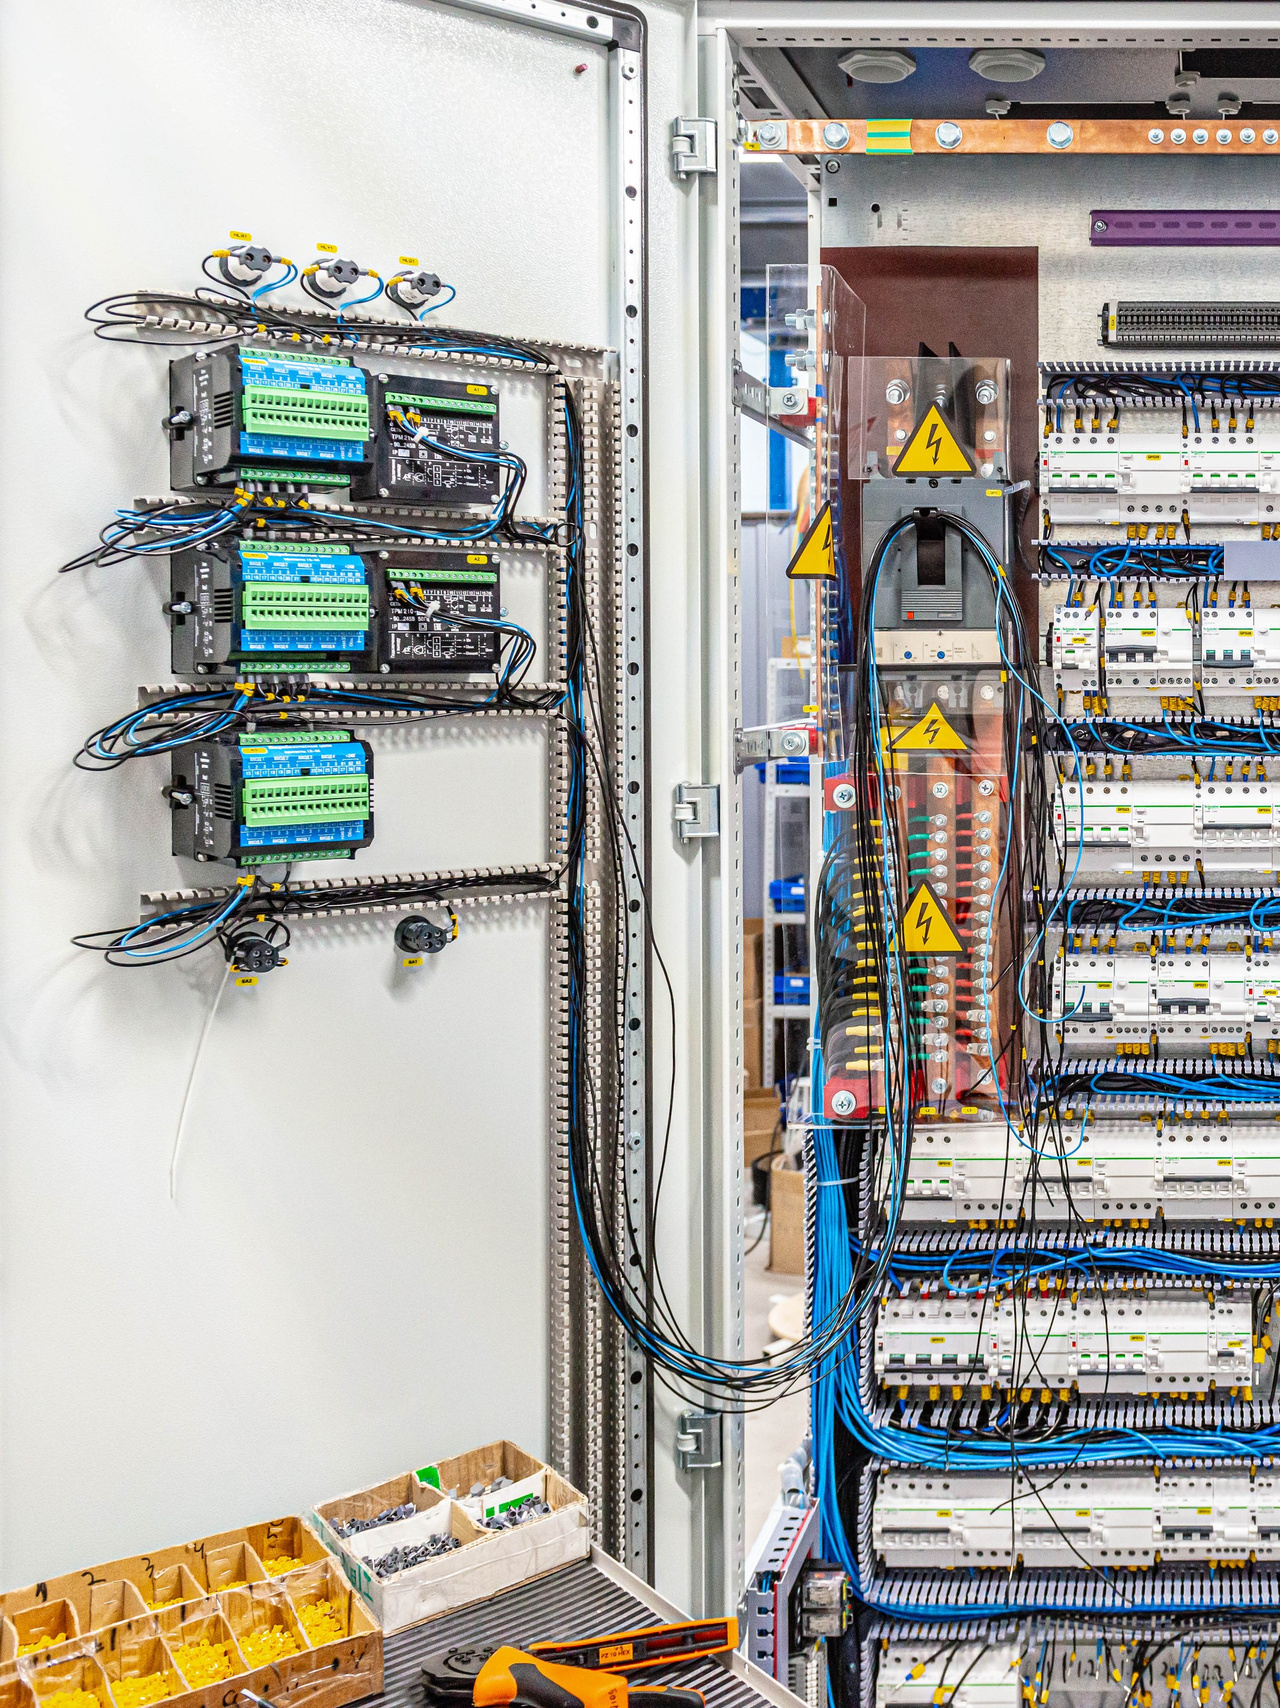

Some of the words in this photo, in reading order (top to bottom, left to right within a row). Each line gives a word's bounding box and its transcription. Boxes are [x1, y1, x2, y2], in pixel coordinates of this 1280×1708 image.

[194, 1542, 205, 1559] 4
[141, 1557, 155, 1578] 3
[81, 1571, 106, 1586] 2
